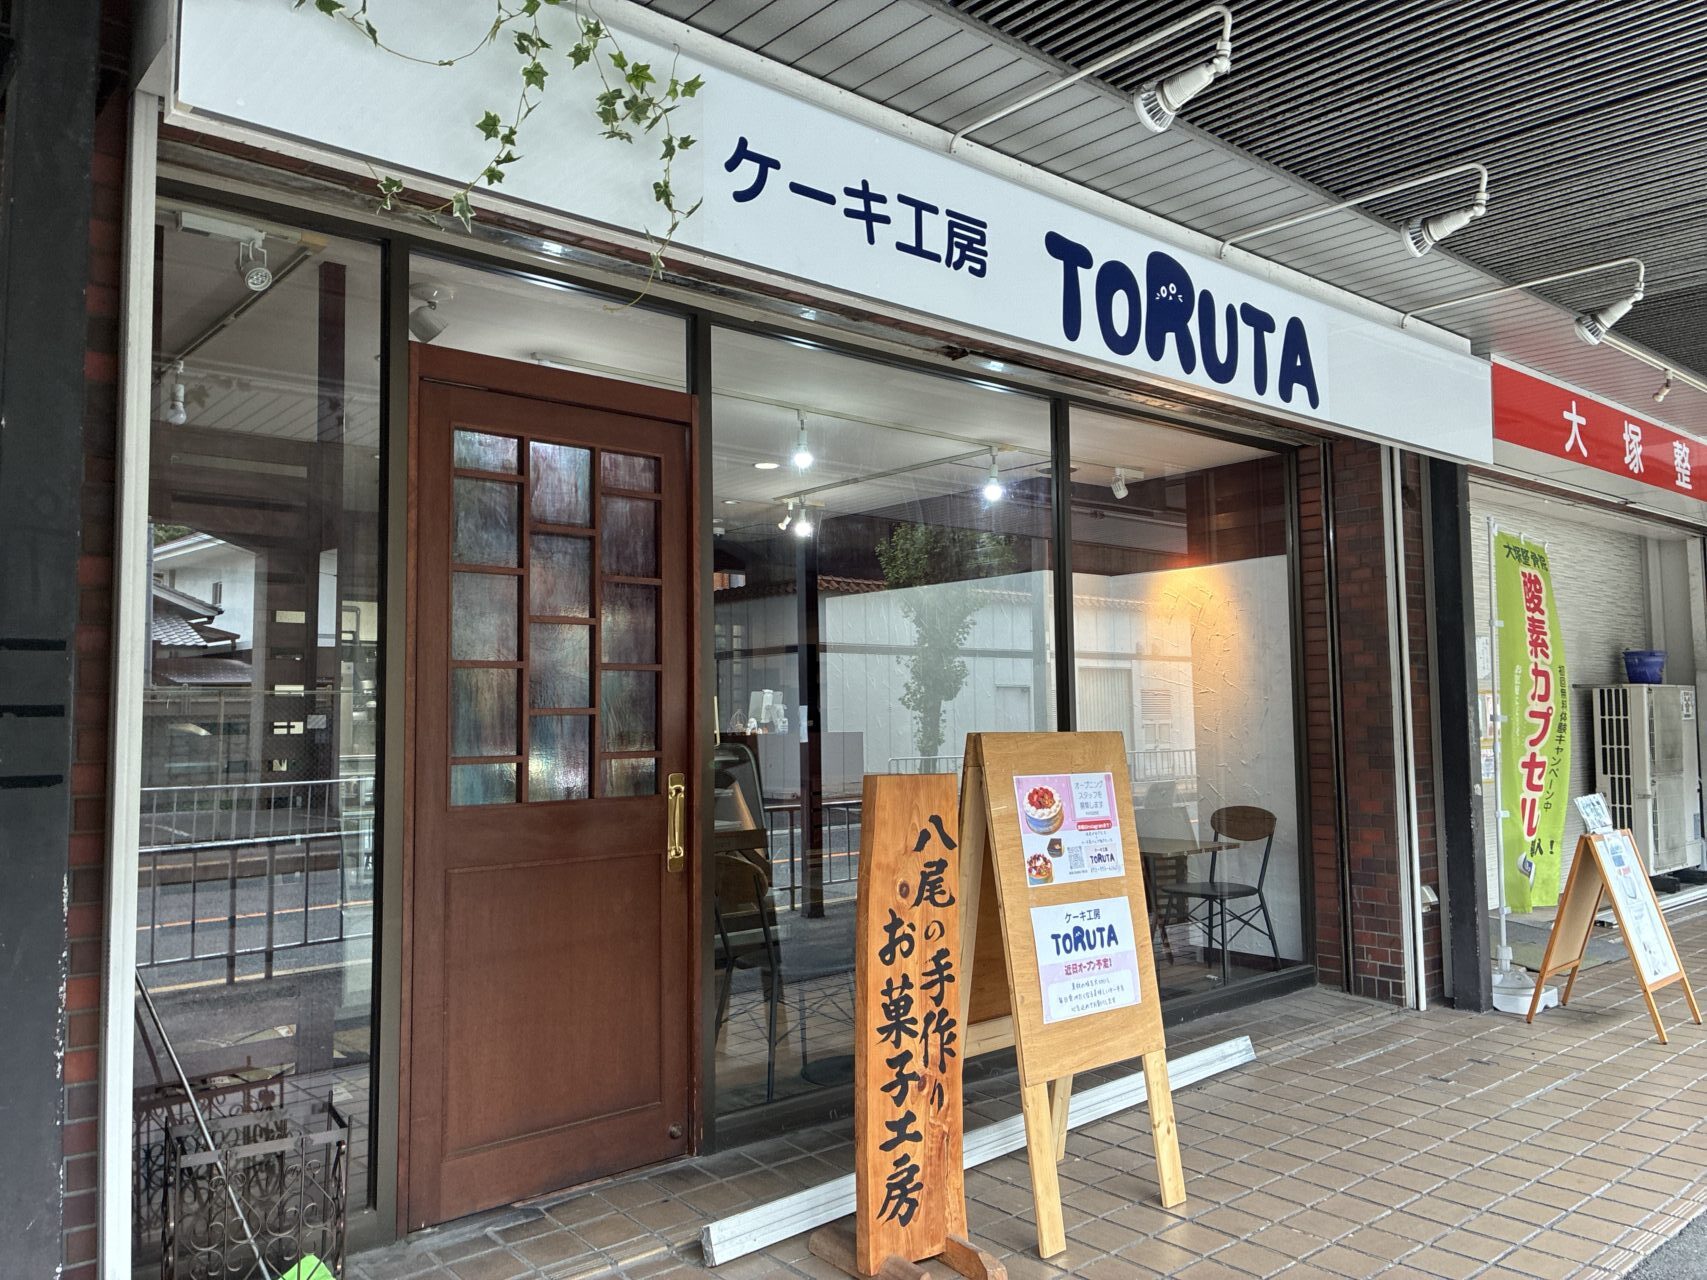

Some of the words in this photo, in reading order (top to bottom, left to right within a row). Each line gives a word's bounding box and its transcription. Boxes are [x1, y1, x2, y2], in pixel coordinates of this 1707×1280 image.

[724, 136, 989, 278] ケーキ工房
[1045, 231, 1319, 410] TORUTA
[1563, 401, 1692, 489] 大塚整
[1521, 571, 1553, 837] 酸素カプセル
[1065, 908, 1101, 923] ケーキ工房
[1090, 853, 1115, 864] TORUTA
[913, 815, 958, 1112] 八尾の手作り
[1051, 924, 1118, 956] TORUTA
[876, 907, 925, 1228] お菓子工房
